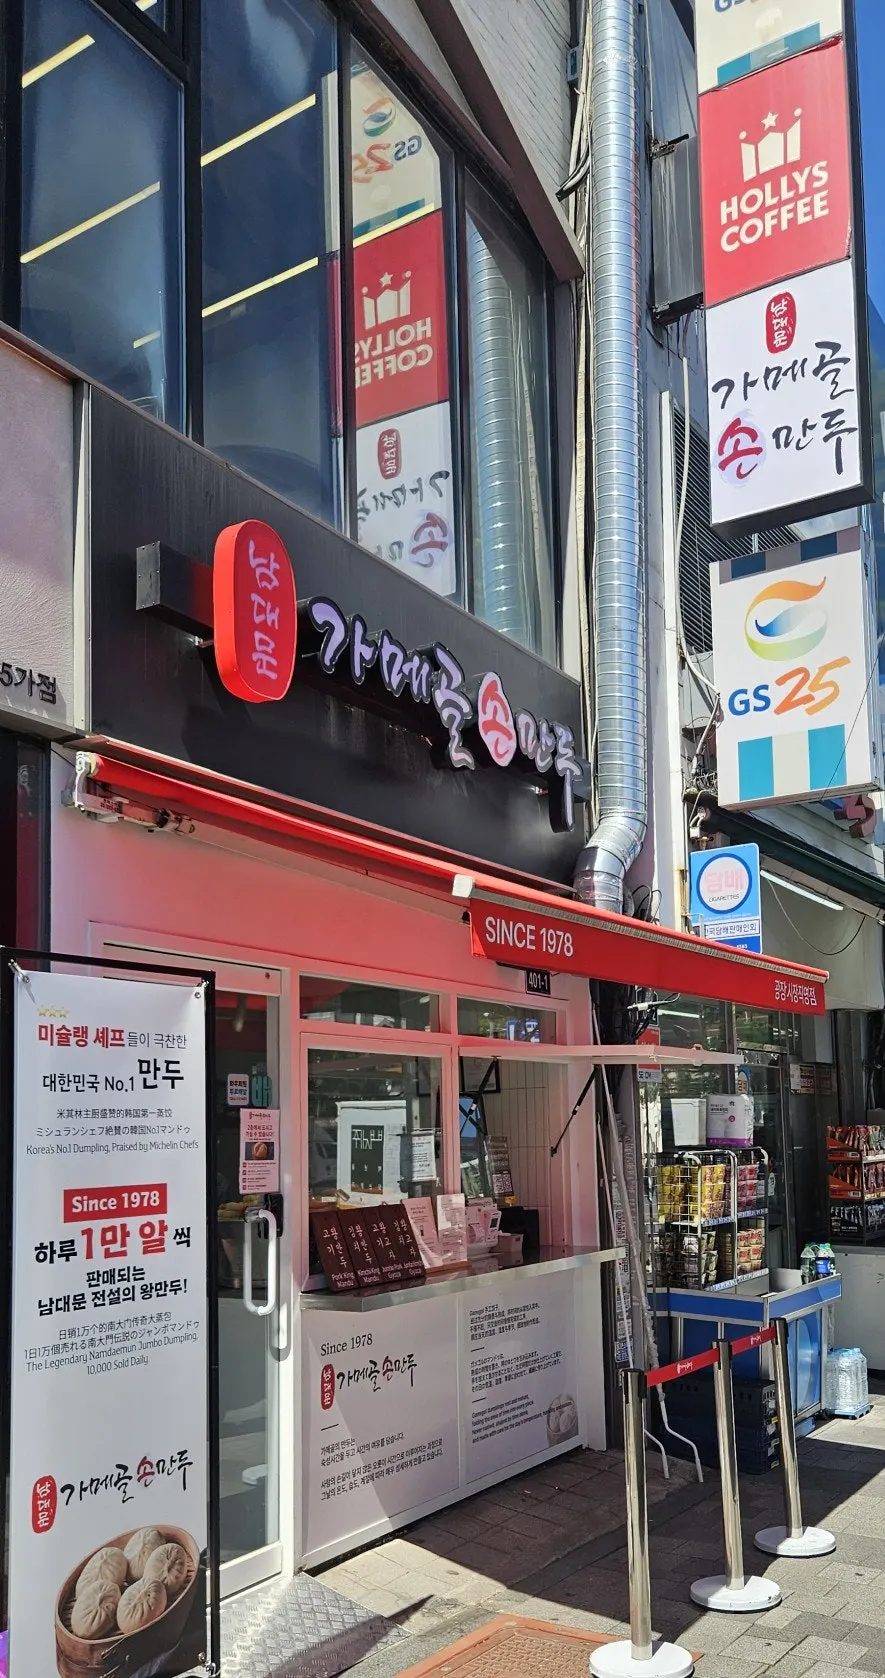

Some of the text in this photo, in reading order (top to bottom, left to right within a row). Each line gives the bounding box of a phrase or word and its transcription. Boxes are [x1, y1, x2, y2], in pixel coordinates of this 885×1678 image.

[720, 161, 829, 226] HOLLYS
[720, 189, 830, 253] COFFEE
[770, 297, 789, 348] 남대문
[711, 341, 855, 410] 가메골
[717, 408, 858, 479] 손만두
[248, 539, 281, 680] 남대문
[0, 662, 56, 705] 5가점
[309, 597, 582, 832] 가메골 손만두
[705, 869, 744, 893] 담배
[485, 916, 574, 958] SINCE 1978
[704, 923, 757, 937] 국담배판매인회
[528, 971, 550, 990] 401-1
[774, 979, 818, 1006] 광장시장직영점
[38, 1024, 89, 1047] 미슐랭
[153, 1033, 188, 1050] 극찬한
[42, 1058, 185, 1093] 대한민국 No.1 만두
[26, 1139, 199, 1155] Korea's No.1 Dumpling, Praised by Michelin Chefs
[71, 1191, 160, 1213] Since 1978
[34, 1219, 192, 1265] 하루 1만 알 씩
[86, 1265, 146, 1289] 판매되는
[38, 1278, 188, 1317] 남대문 전설의 왕만두!
[26, 1332, 199, 1372] The Legendary Namdaemun Jumbo Dumpling,
[86, 1354, 149, 1375] 10,000 Sold Daily
[320, 1333, 373, 1357] Since 1978
[336, 1353, 418, 1393] 가메골 손만두
[60, 1449, 194, 1506] 가메골 손만두
[36, 1482, 51, 1528] 남대문
